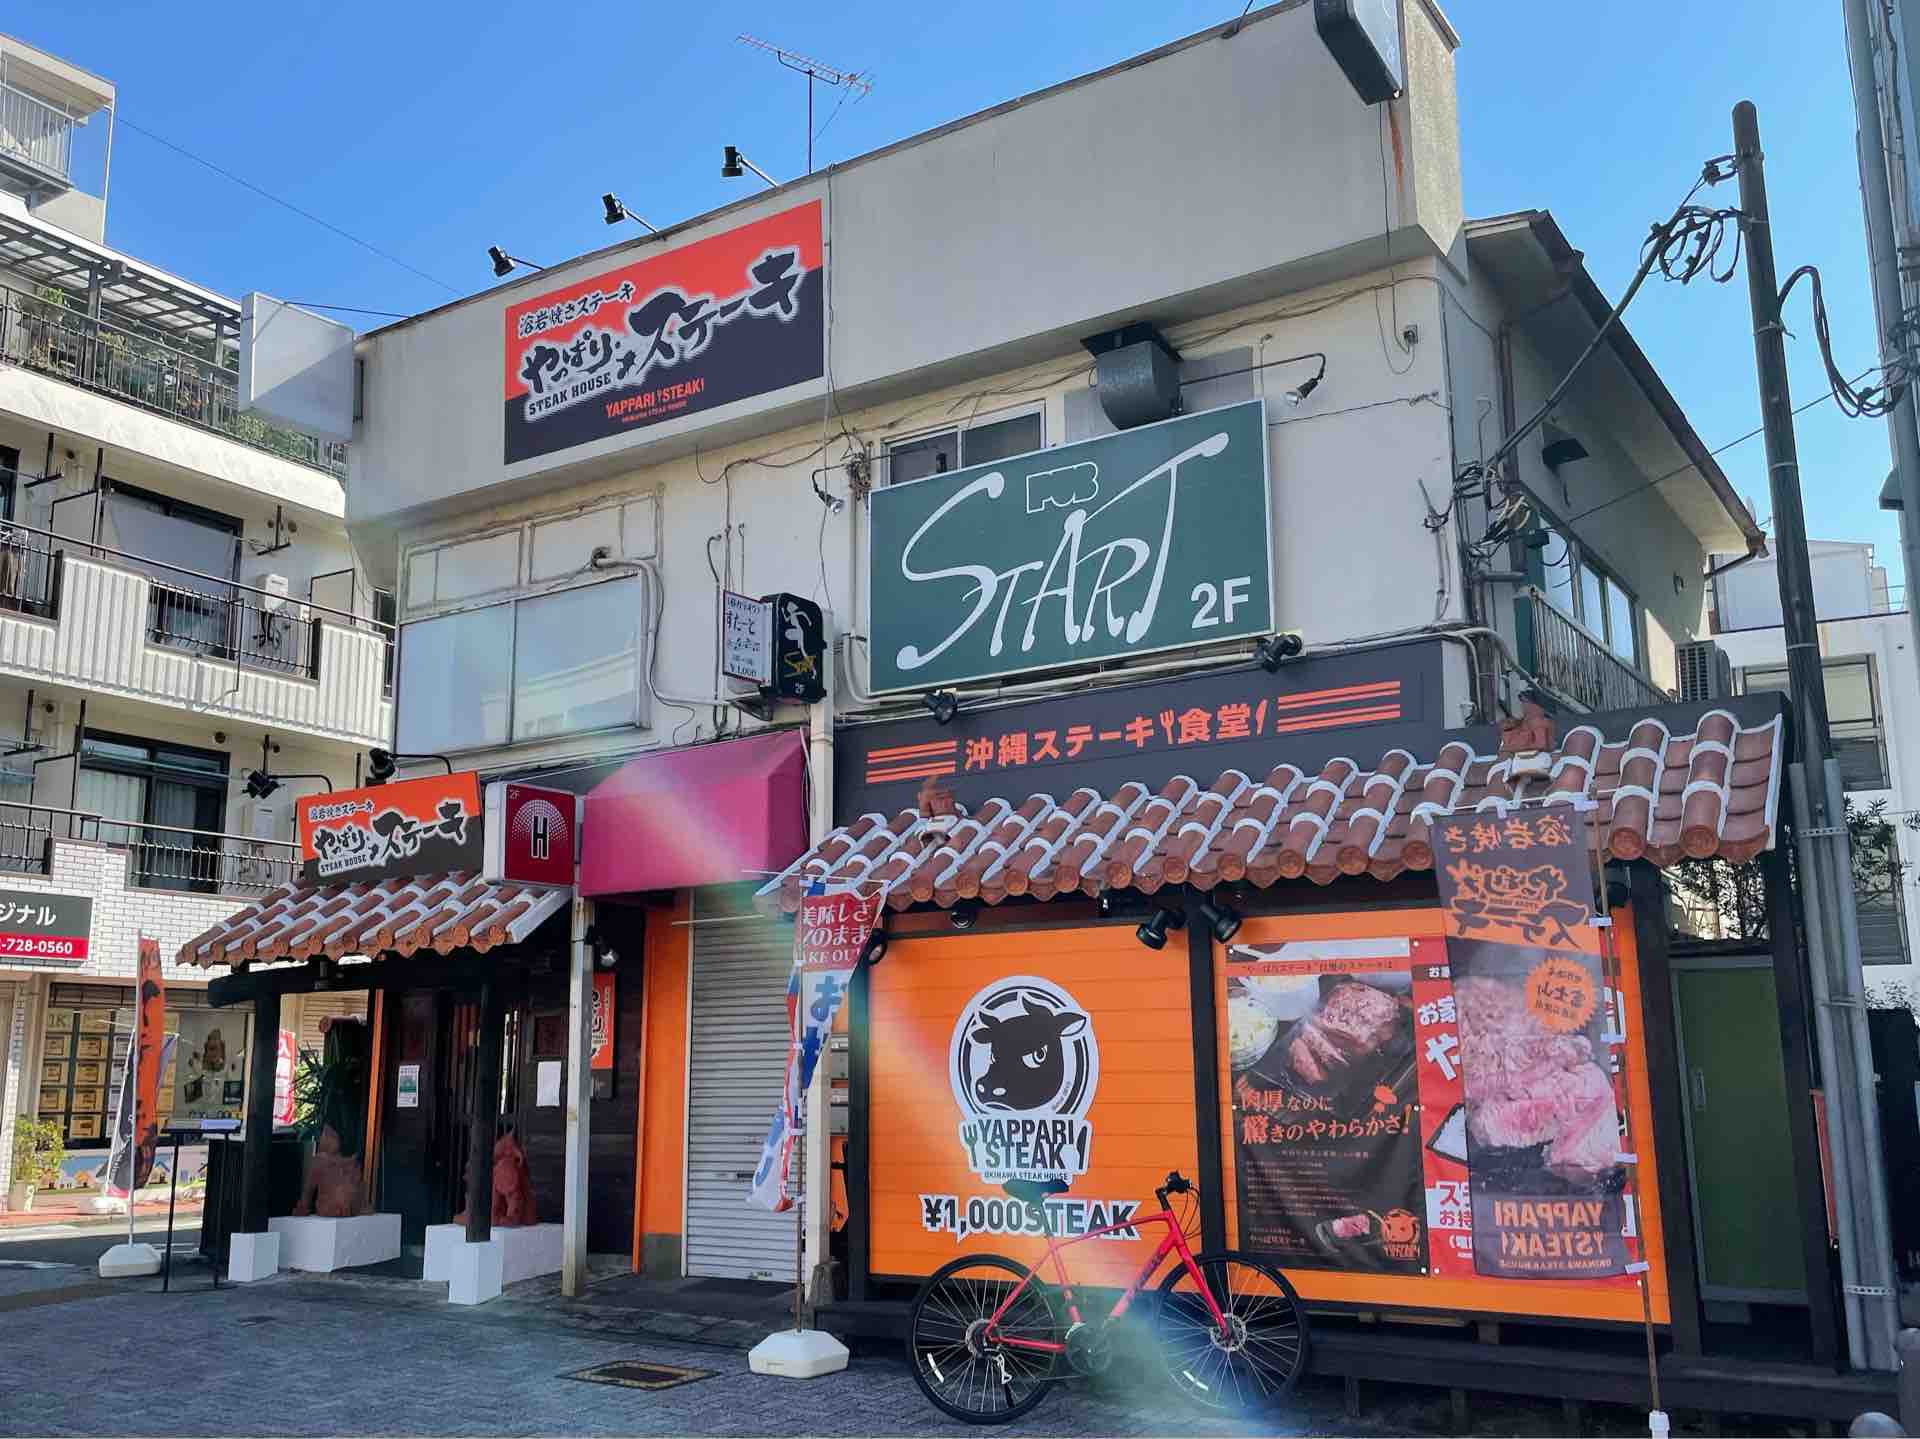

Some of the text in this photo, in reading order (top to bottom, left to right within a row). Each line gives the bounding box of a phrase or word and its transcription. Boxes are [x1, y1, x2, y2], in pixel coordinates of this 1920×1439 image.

[528, 371, 612, 416] STEAK HOUSE
[606, 391, 655, 418] YAPPARI
[896, 431, 1230, 671] START
[1190, 575, 1252, 630] 2F
[320, 861, 344, 873] STEAK
[0, 902, 57, 926] ジナル
[802, 902, 871, 928] 美味しさ
[0, 938, 73, 954] -728-0560
[977, 1119, 1074, 1147] YAPPARI
[985, 1141, 1066, 1169] STEAK
[984, 1171, 1068, 1181] OKINAWA STEAK HOUSE
